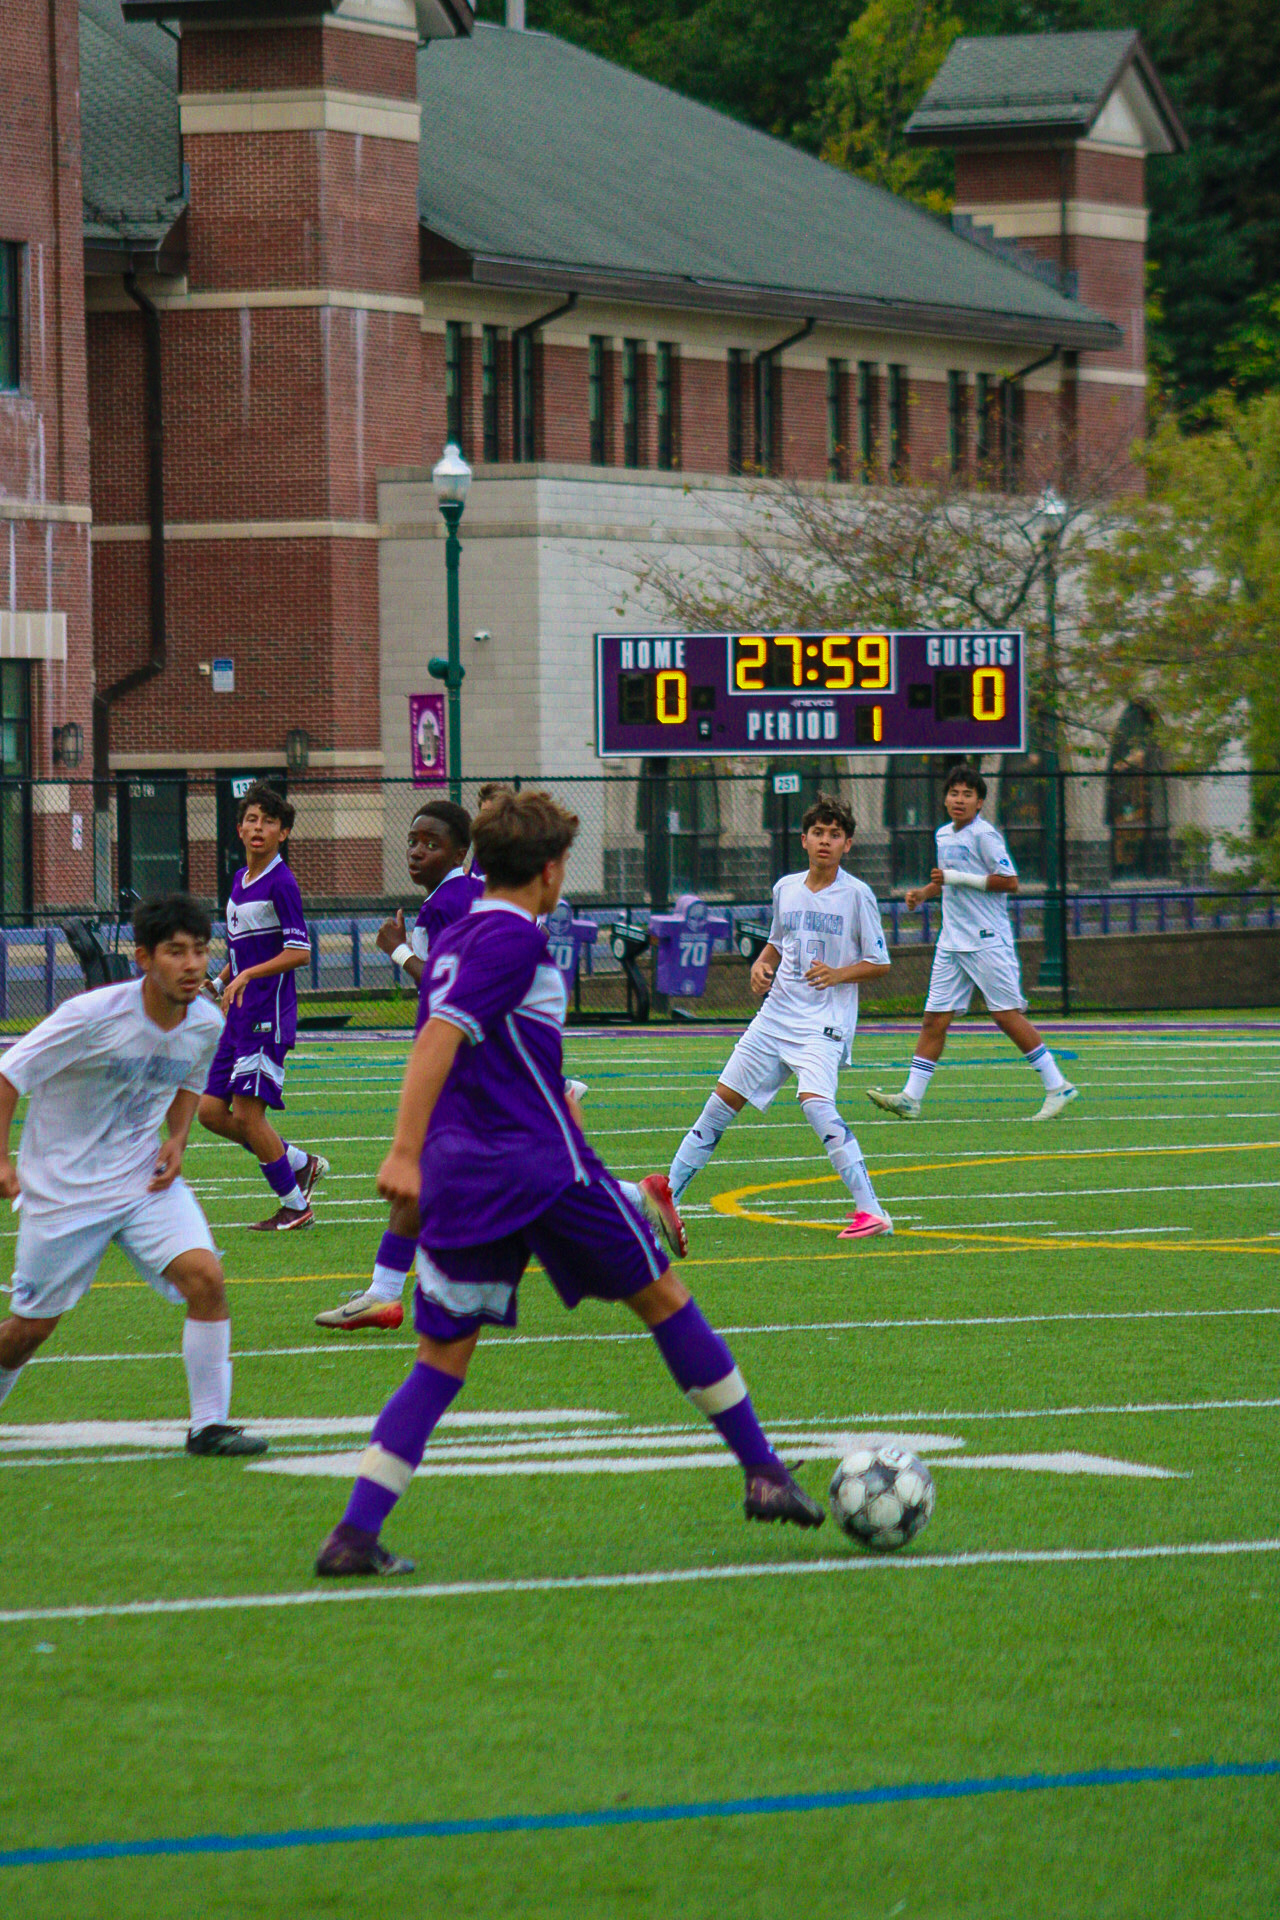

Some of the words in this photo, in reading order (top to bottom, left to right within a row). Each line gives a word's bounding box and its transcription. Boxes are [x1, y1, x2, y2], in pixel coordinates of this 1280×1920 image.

[621, 640, 686, 669] HOME
[736, 636, 889, 689] 27:59
[926, 637, 1013, 667] GUESTS
[656, 670, 687, 724] 0
[972, 667, 1006, 721] 0
[747, 711, 839, 740] PERIOD
[873, 705, 882, 742] 1
[779, 777, 796, 791] 251
[803, 910, 844, 936] CHESTER
[679, 941, 707, 967] 70
[428, 954, 459, 1012] 2
